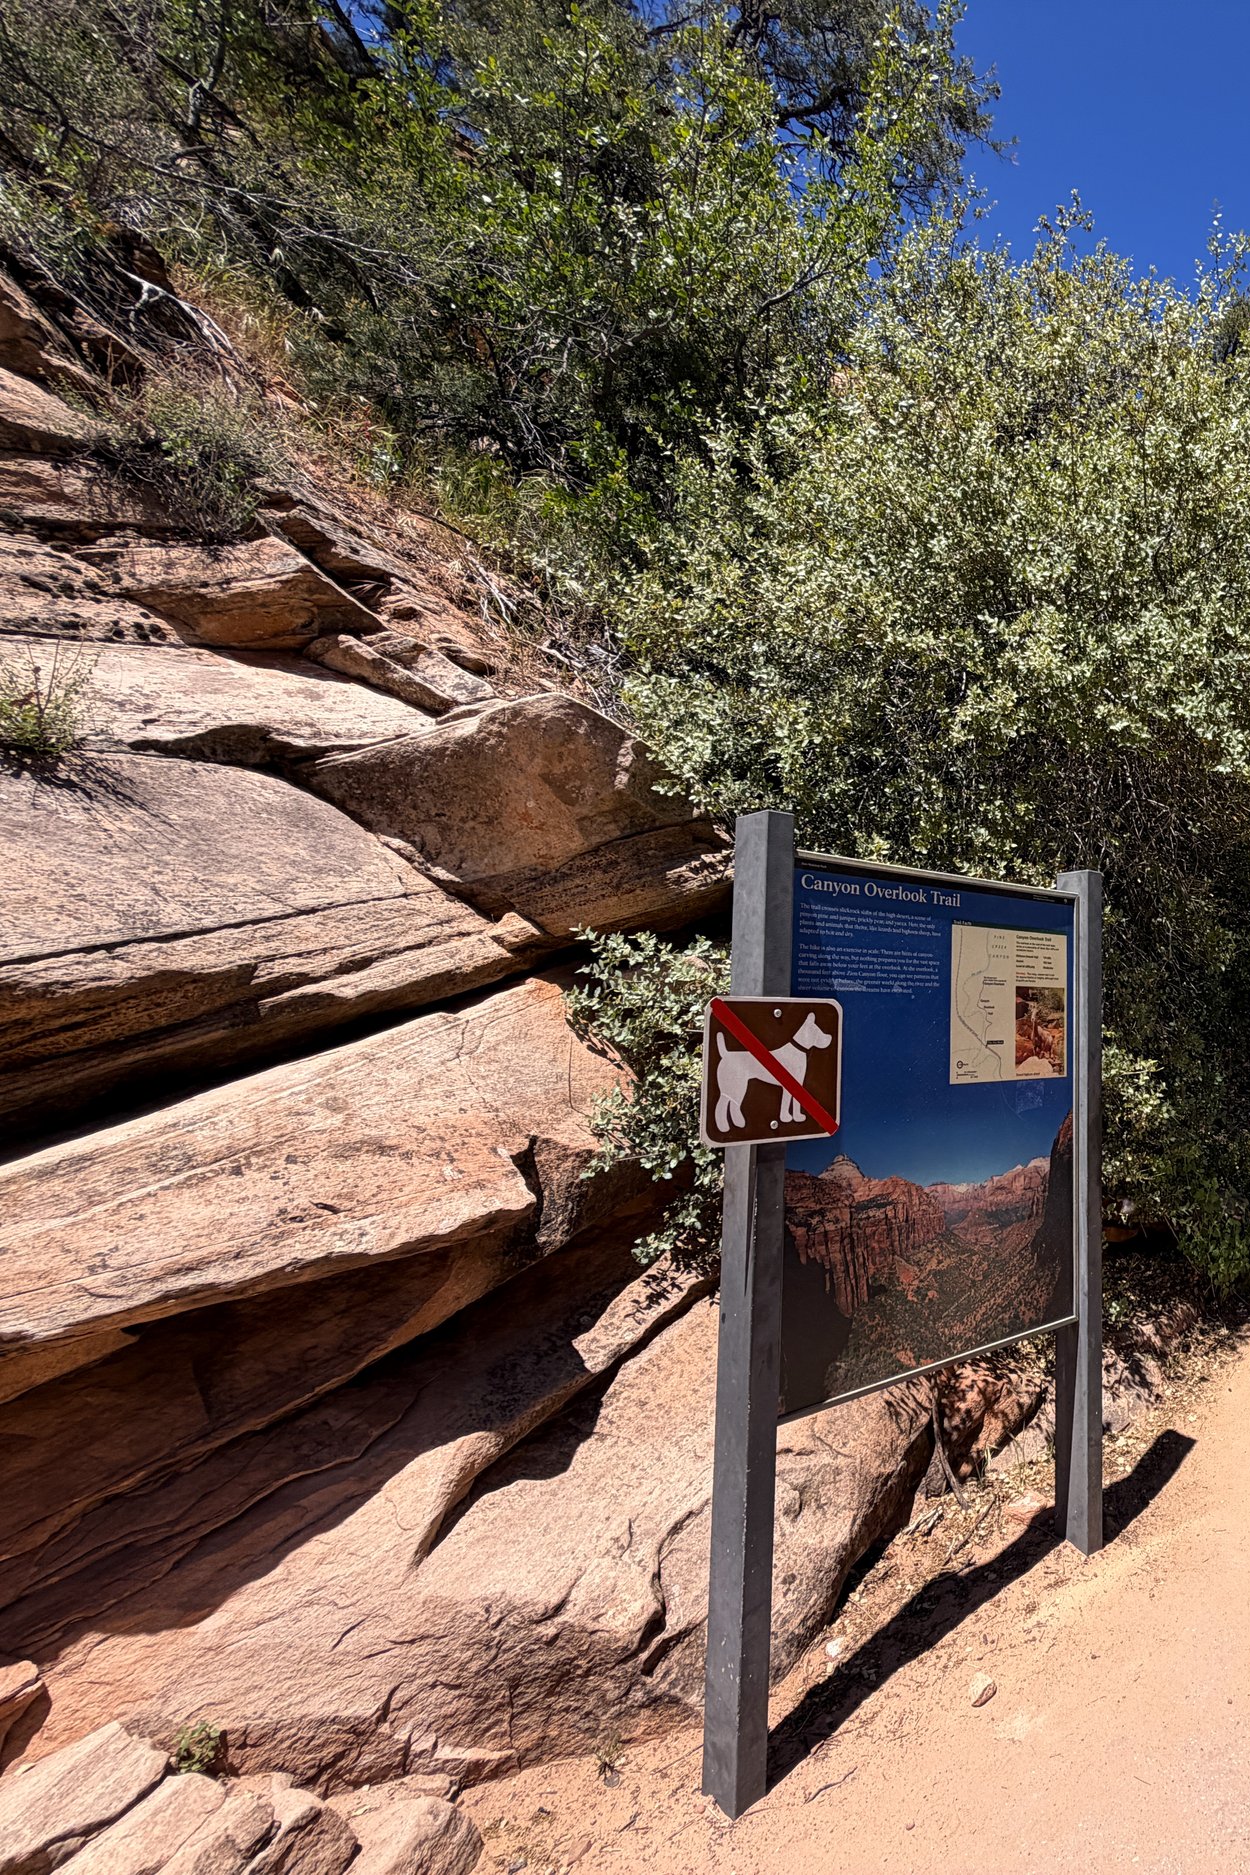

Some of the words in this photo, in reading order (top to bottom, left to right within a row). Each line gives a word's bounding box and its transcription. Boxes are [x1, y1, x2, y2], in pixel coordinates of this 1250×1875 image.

[801, 874, 860, 896] Canyon
[864, 882, 928, 903] Overlook
[930, 890, 961, 907] Trail
